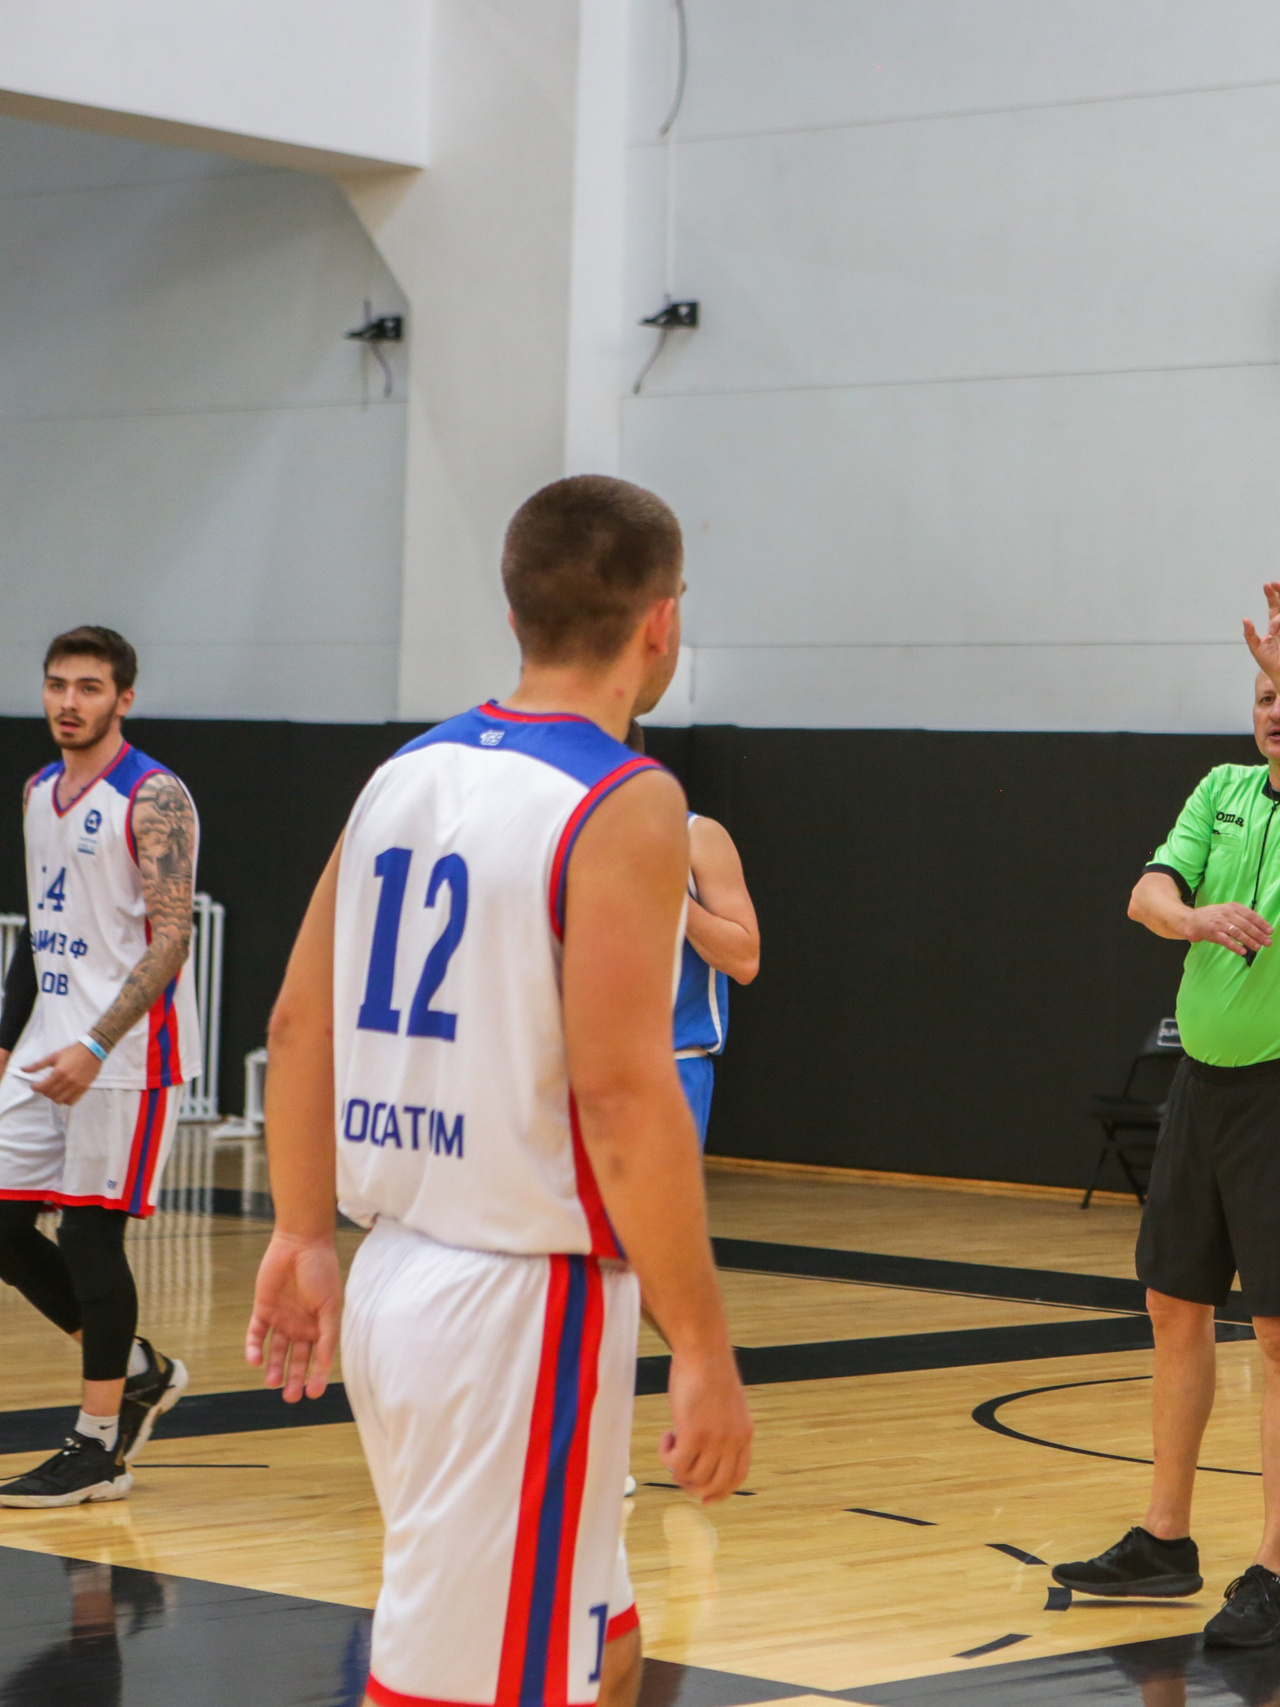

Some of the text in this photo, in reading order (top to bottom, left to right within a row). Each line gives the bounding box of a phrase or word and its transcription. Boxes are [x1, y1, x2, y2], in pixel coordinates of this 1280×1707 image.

[1215, 811, 1245, 828] oma
[356, 846, 469, 1042] 12
[342, 1098, 464, 1159] ОСАТМ
